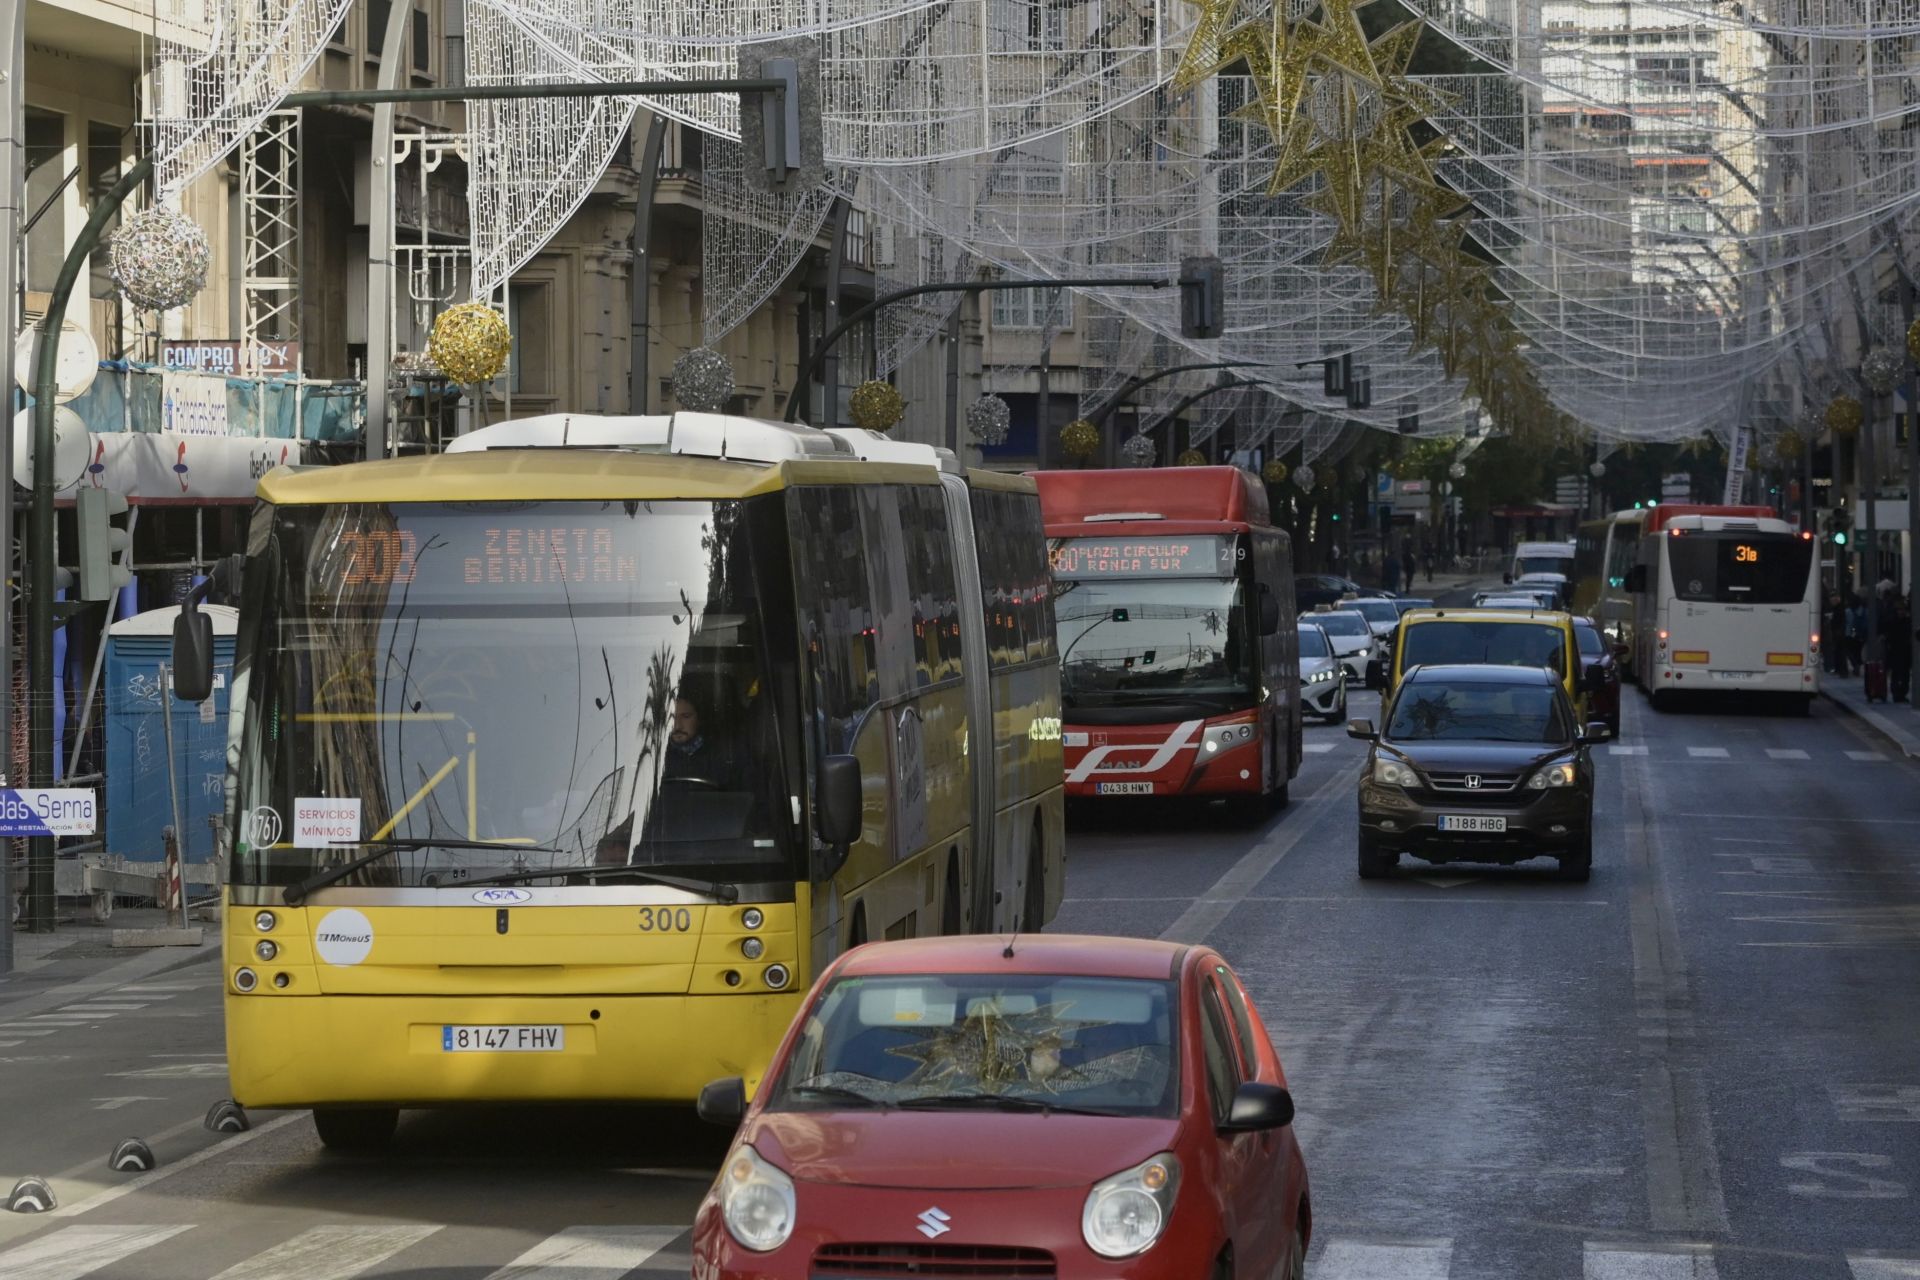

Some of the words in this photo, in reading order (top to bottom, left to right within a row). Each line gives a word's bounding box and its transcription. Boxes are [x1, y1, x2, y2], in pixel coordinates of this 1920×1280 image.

[164, 346, 234, 366] COMPRO
[485, 528, 614, 555] ZENETA
[1049, 547, 1078, 572] R80
[1079, 546, 1119, 559] PLAZA
[1124, 545, 1190, 558] CIRCULAR
[1221, 548, 1246, 561] 219
[1736, 546, 1757, 561] 31B
[464, 557, 640, 583] BENIAJAN
[1088, 558, 1142, 572] RONDA
[1149, 558, 1182, 570] SUR
[1100, 761, 1140, 769] MAN
[1102, 784, 1128, 793] 0438
[37, 793, 92, 820] Serna
[299, 809, 356, 820] SERVICIOS
[250, 815, 277, 841] 3761
[302, 825, 352, 837] MÍNIMOS
[1448, 818, 1477, 829] 1188
[1480, 818, 1503, 830] HBG
[638, 907, 691, 932] 300
[457, 1029, 510, 1048] 8147
[518, 1028, 558, 1048] FHV
